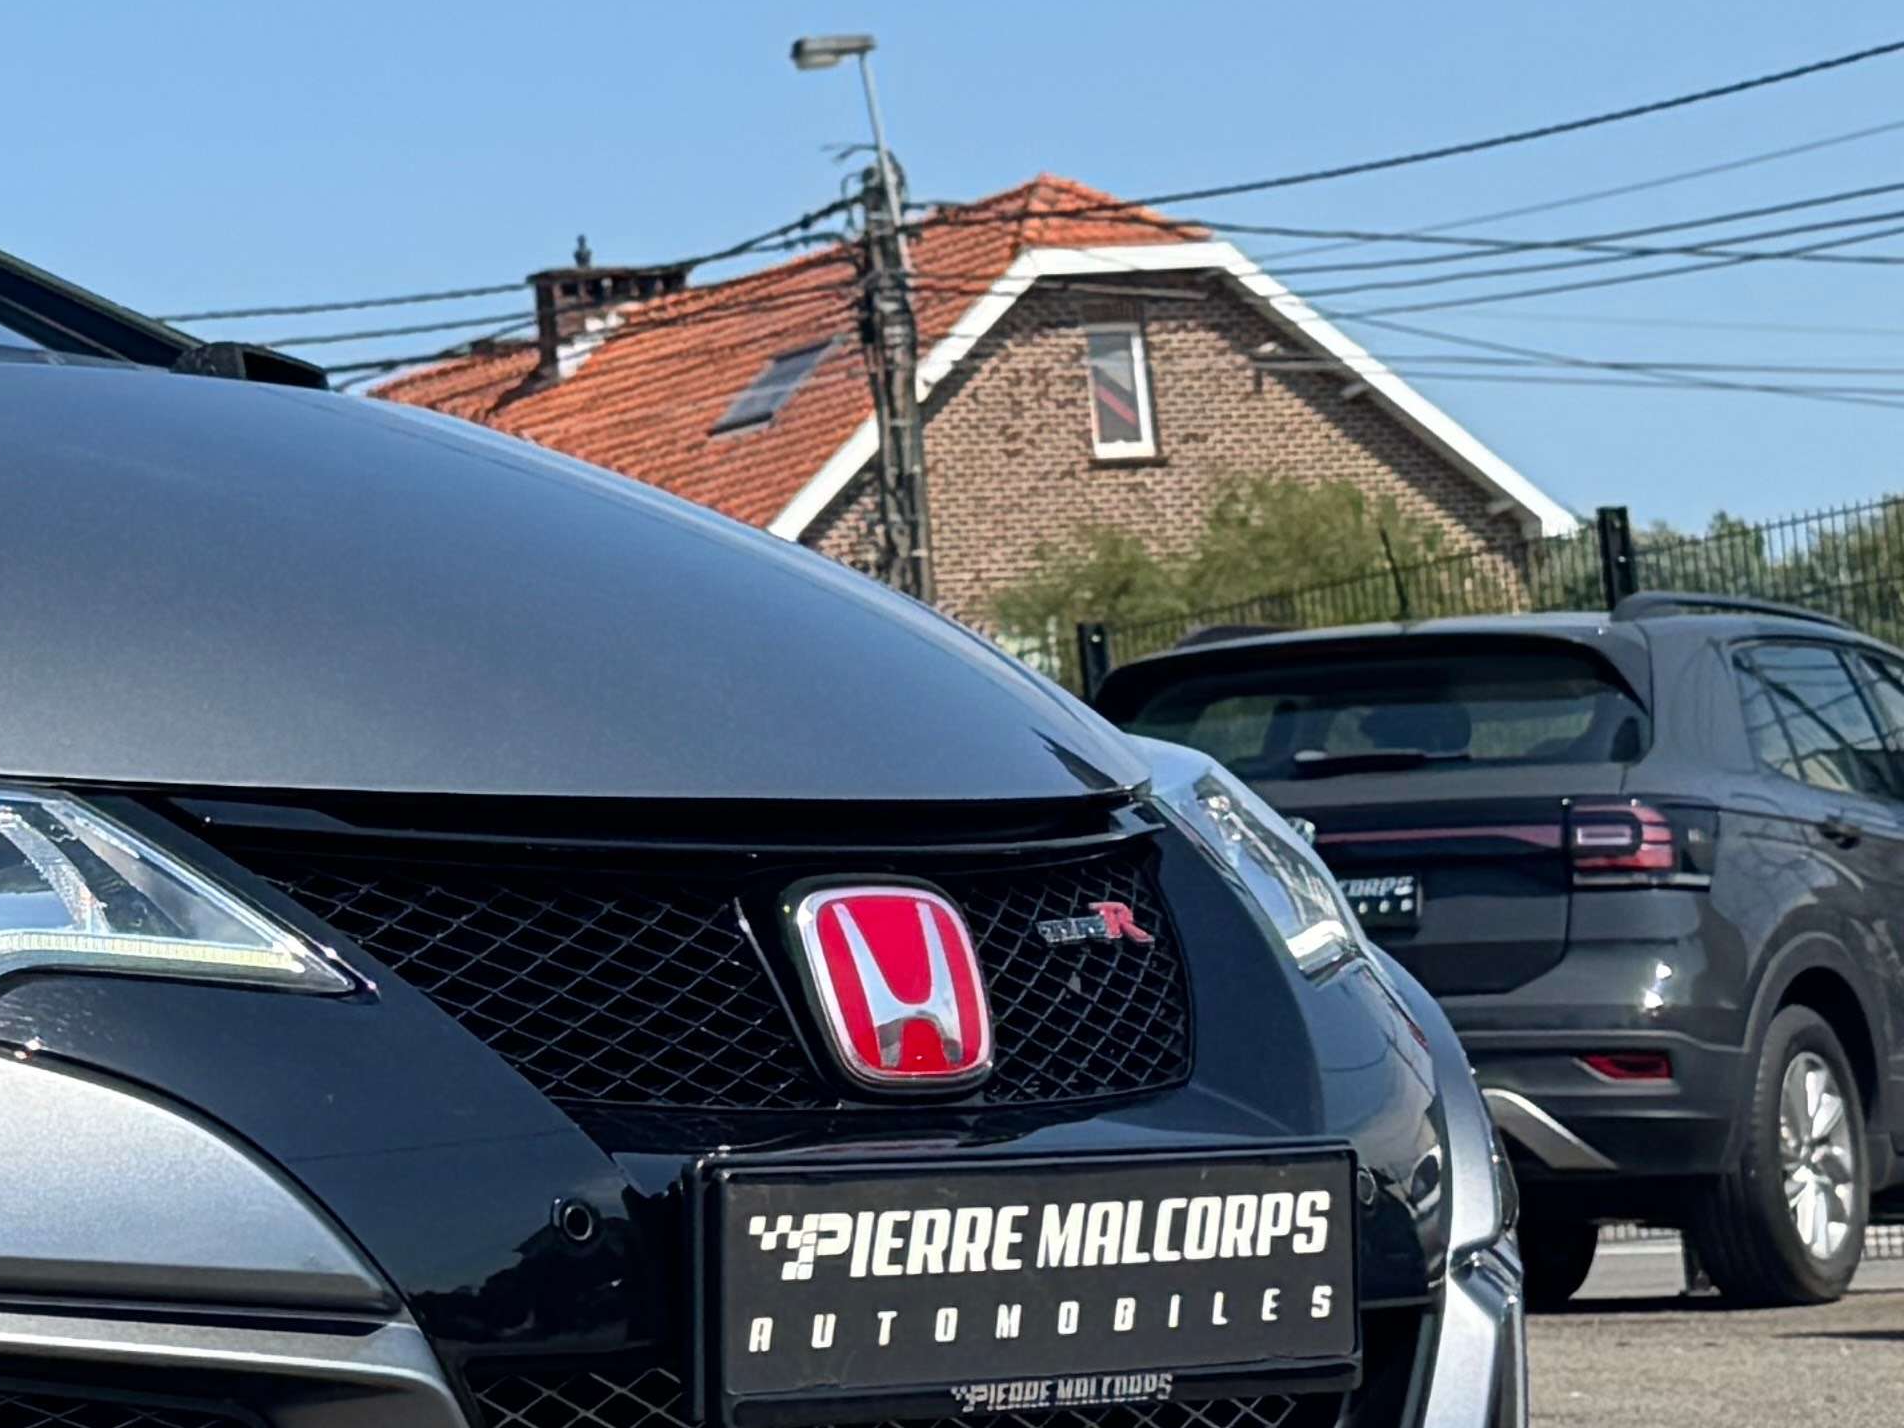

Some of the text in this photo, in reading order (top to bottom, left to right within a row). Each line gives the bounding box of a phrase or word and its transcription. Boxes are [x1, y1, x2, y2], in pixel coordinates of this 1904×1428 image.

[748, 1189, 1331, 1281] PIERRE MALCORPS
[748, 1285, 1333, 1353] AUTOMOBILES
